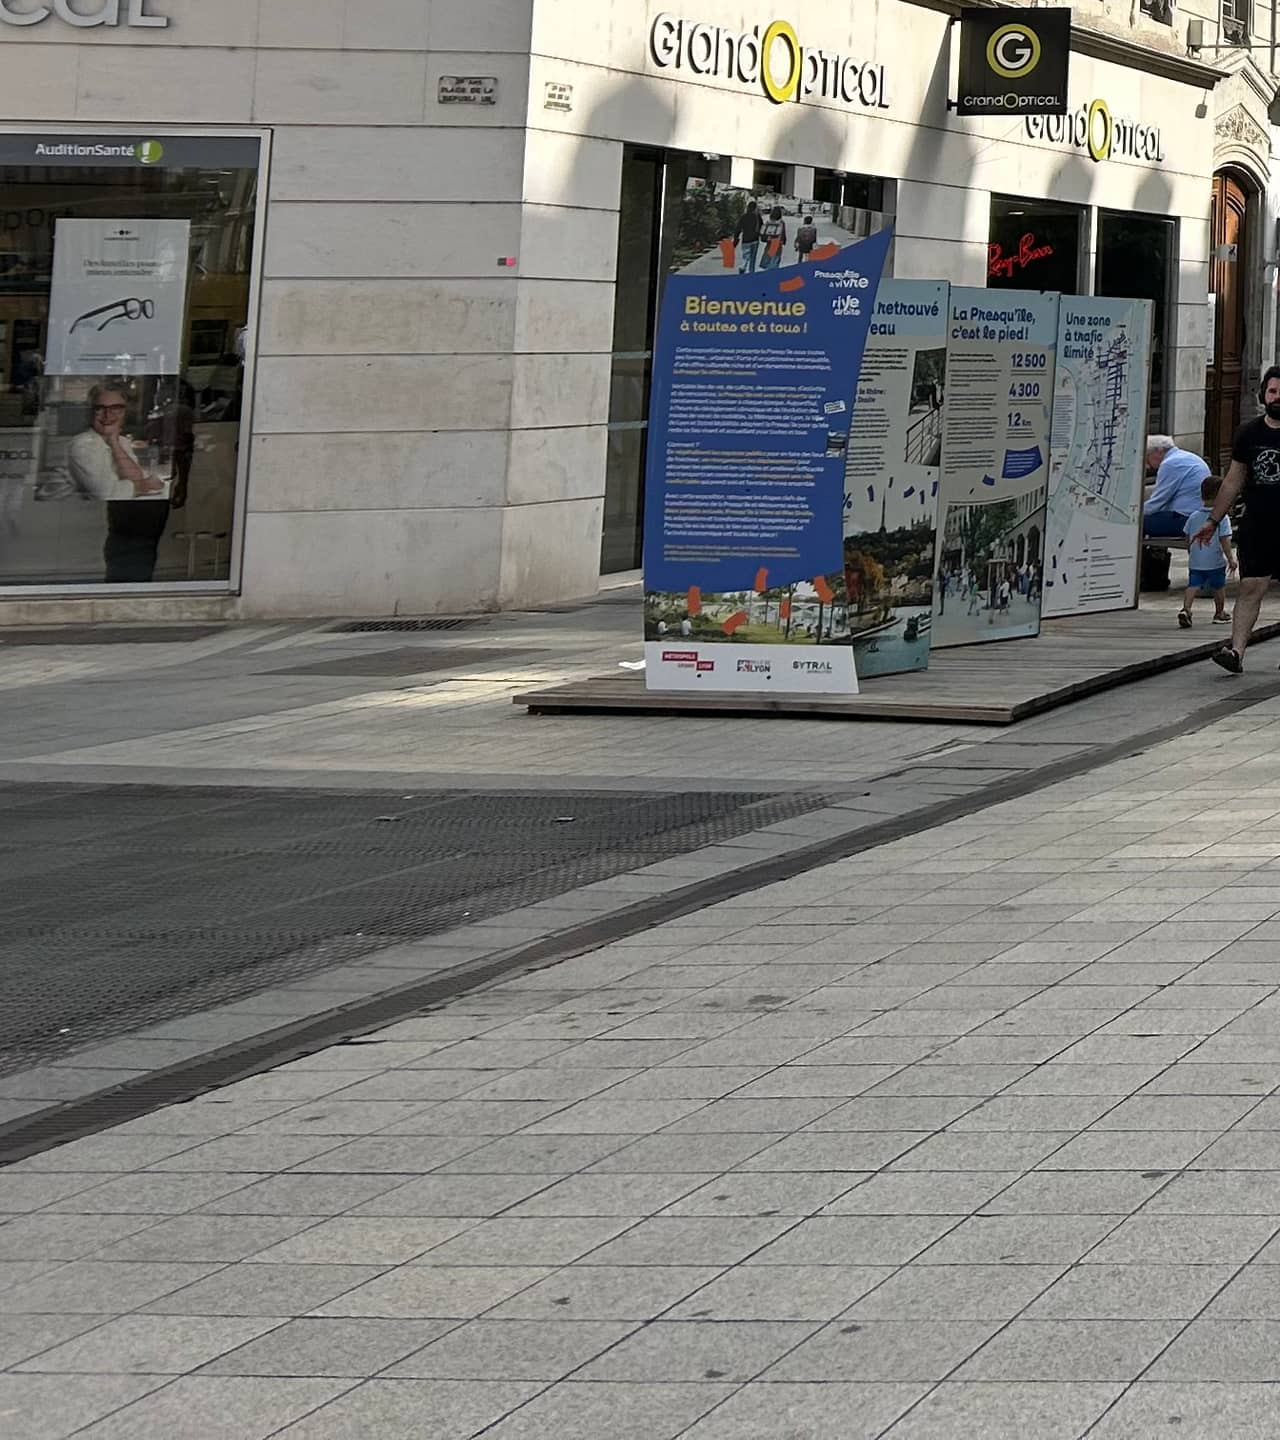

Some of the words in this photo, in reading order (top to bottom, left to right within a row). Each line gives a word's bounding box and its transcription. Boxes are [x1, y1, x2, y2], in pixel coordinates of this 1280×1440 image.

[650, 12, 889, 105] GrandOptical
[964, 93, 1060, 108] GrandOptical
[35, 143, 135, 157] AuditionSanté
[988, 232, 1053, 277] Ray-Ban
[685, 295, 806, 316] Bienvenue
[832, 295, 860, 311] rive
[878, 301, 939, 317] retrouvé
[953, 307, 967, 321] La
[1066, 312, 1086, 326] Une
[1088, 316, 1111, 327] zone
[680, 320, 690, 332] à
[693, 320, 737, 333] toutes
[740, 322, 754, 333] et
[757, 321, 767, 333] à
[770, 322, 801, 334] tous
[952, 325, 980, 340] c'est
[982, 326, 996, 340] le
[1064, 329, 1072, 342] à
[1074, 329, 1103, 345] trafic
[1063, 345, 1094, 359] limité
[792, 661, 832, 670] SYTRAL
